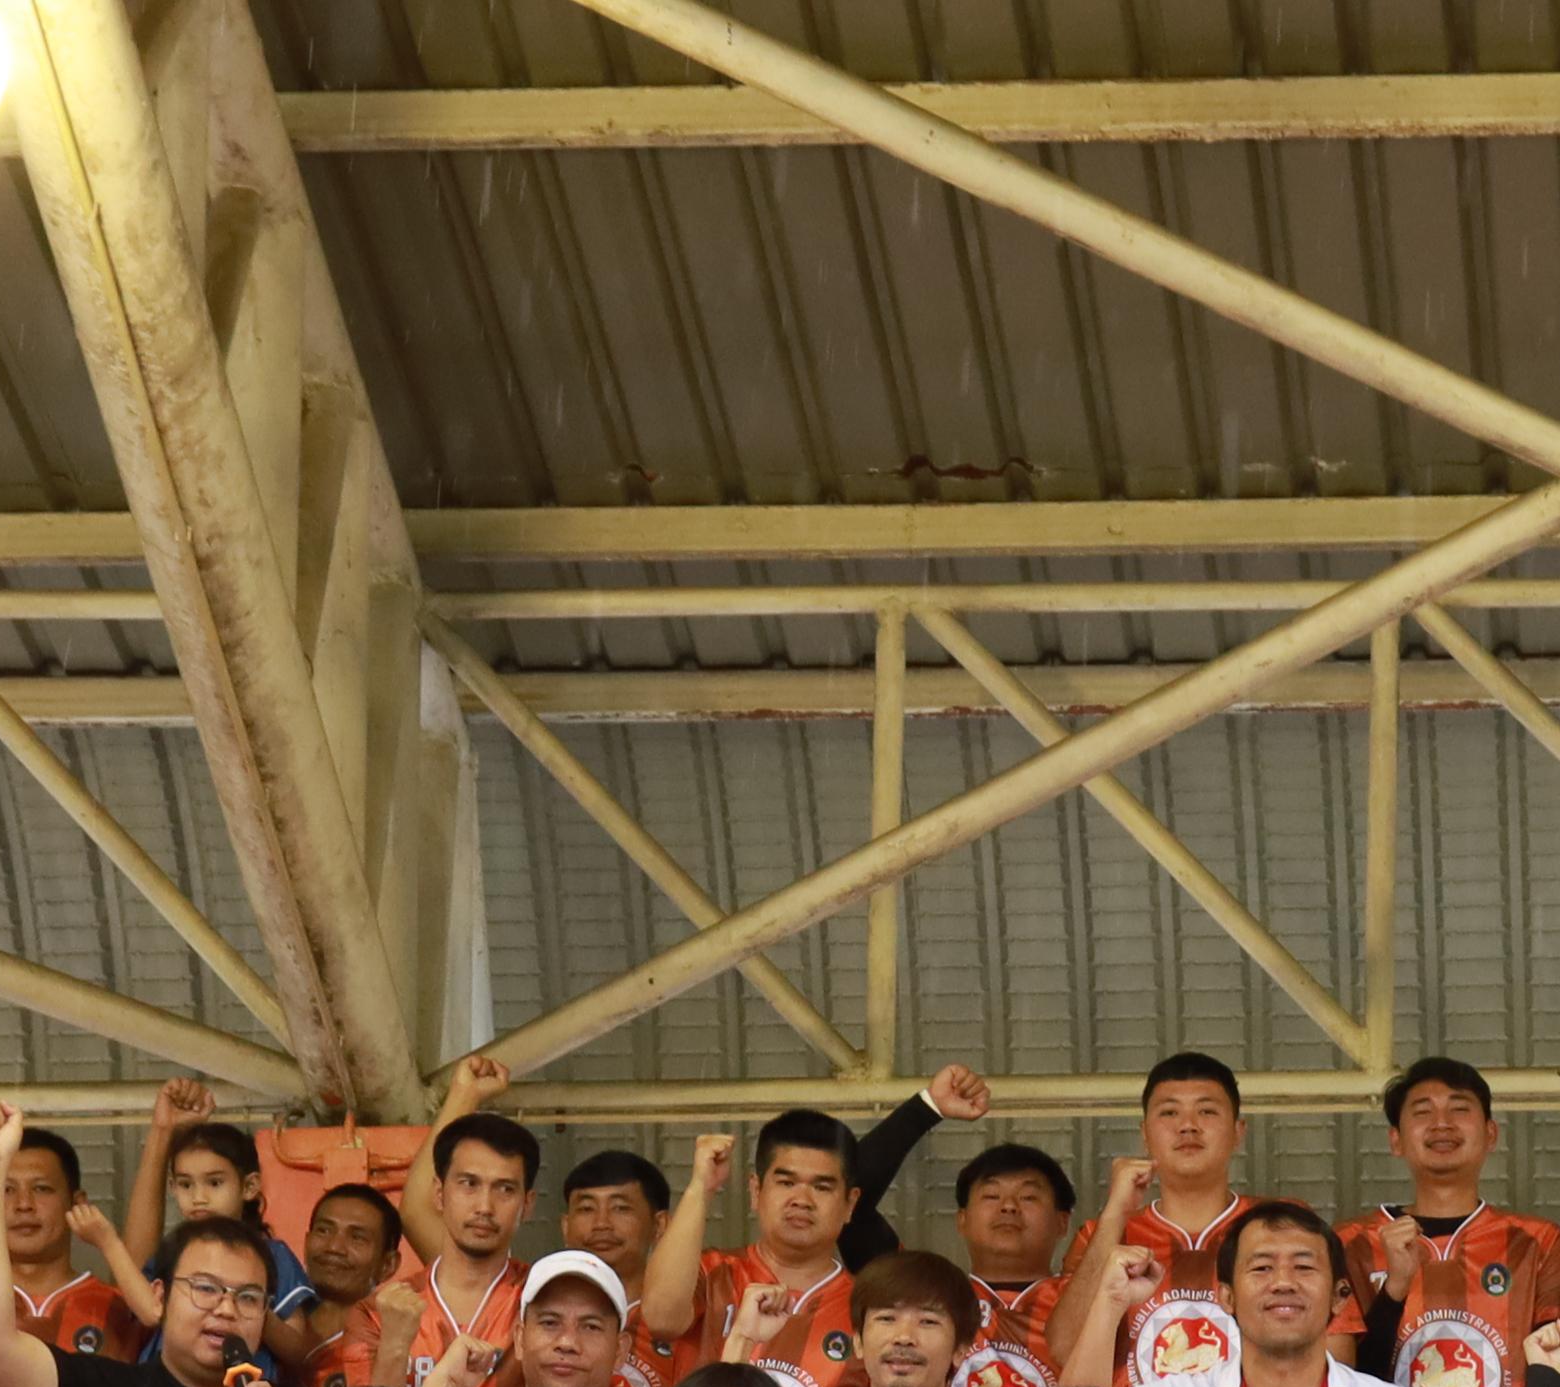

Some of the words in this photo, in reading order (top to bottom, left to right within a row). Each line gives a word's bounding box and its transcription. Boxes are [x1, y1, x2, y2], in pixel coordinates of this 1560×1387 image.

[1128, 1296, 1159, 1339] PUBLIC
[1162, 1288, 1214, 1304] ADMINIS
[1415, 1308, 1508, 1357] ADMINISTRATION
